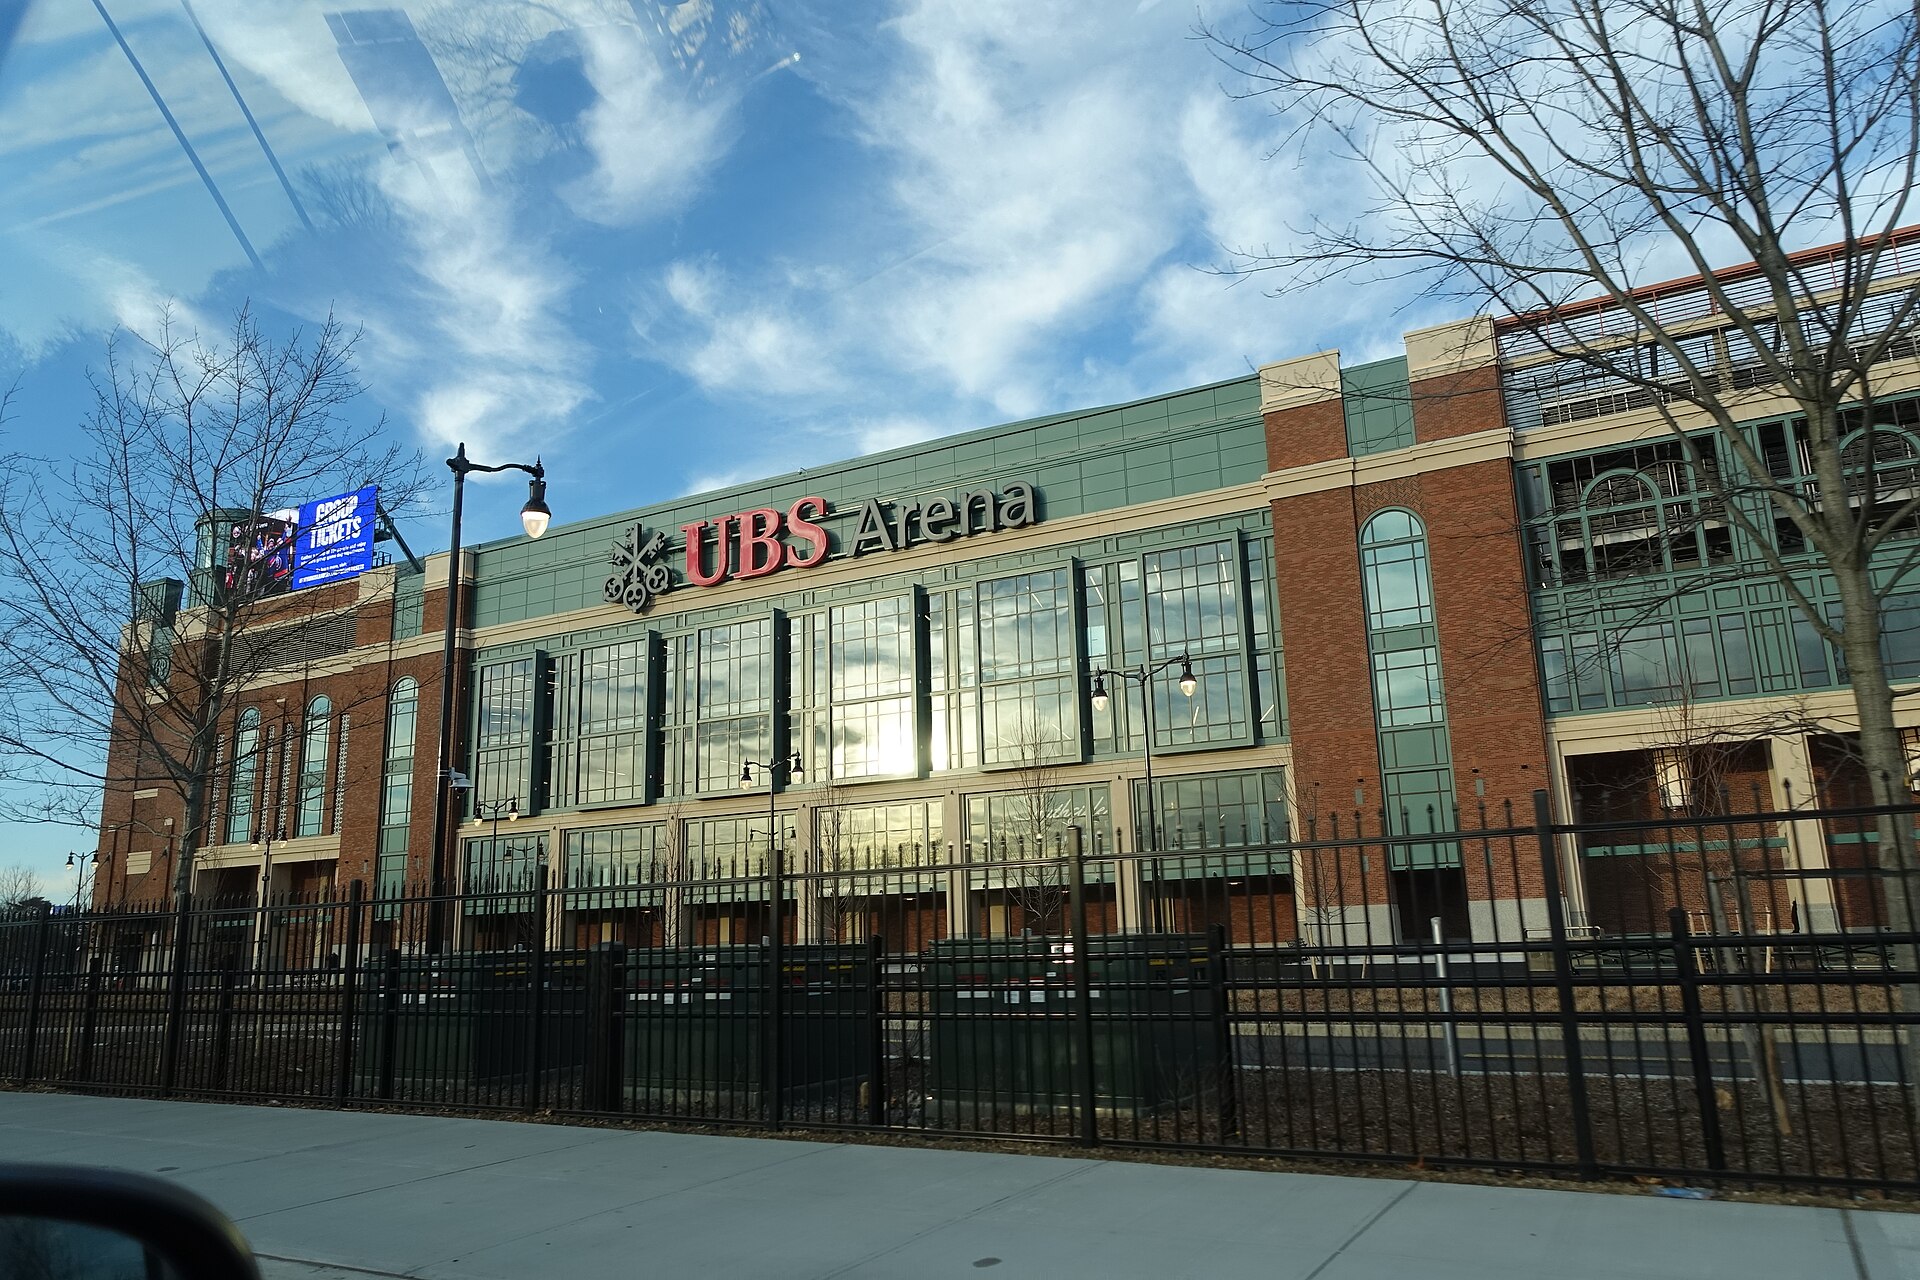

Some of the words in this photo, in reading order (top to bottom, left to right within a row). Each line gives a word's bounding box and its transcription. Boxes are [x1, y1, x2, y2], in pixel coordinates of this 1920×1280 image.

[315, 495, 358, 526] GROUP
[310, 516, 361, 548] TICKETS
[680, 496, 830, 587] UBS
[847, 480, 1037, 557] Arena
